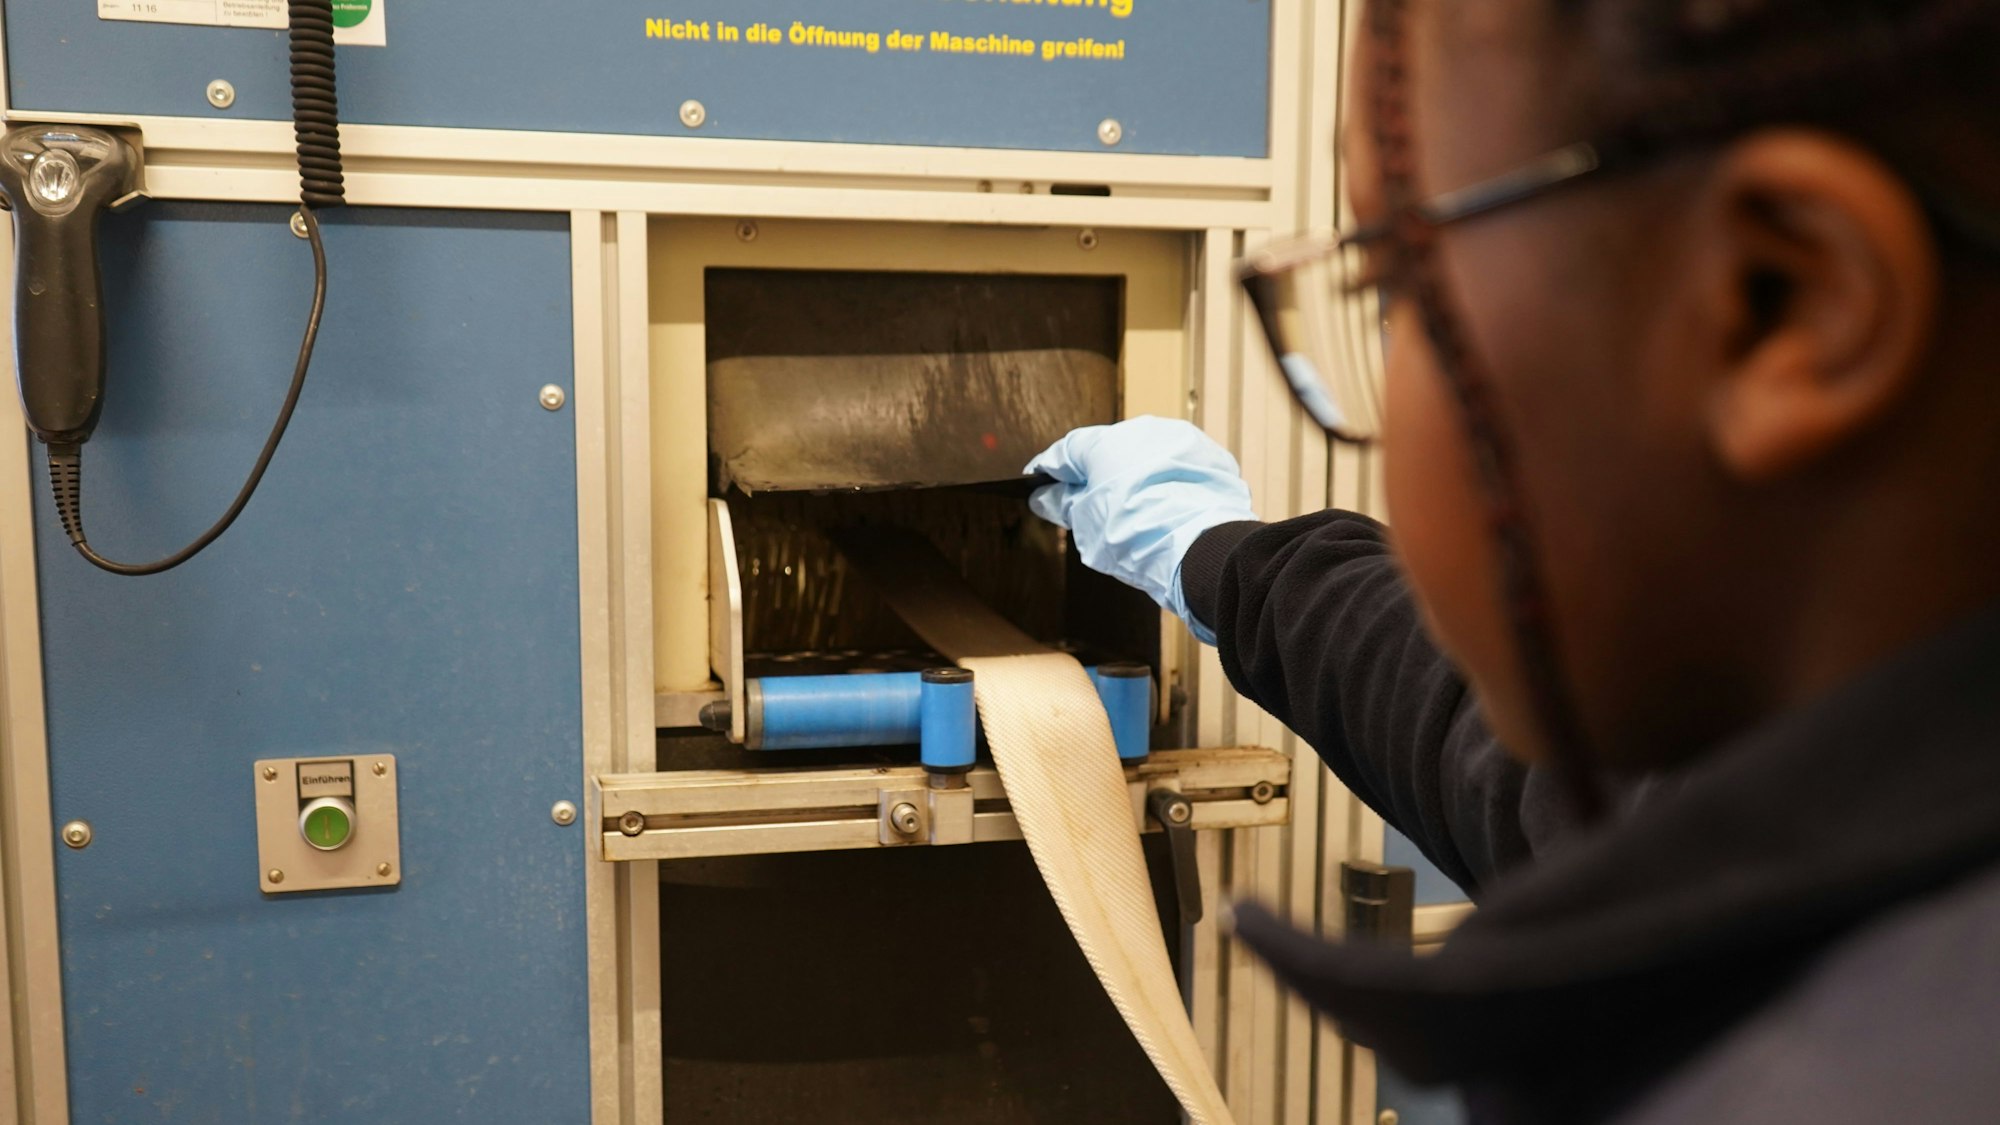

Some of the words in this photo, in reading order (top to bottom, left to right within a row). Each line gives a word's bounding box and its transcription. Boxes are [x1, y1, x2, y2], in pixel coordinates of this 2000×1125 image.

[132, 3, 142, 12] 11
[146, 4, 157, 13] 16
[645, 18, 710, 41] Nicht
[717, 21, 739, 41] in
[745, 23, 782, 44] die
[788, 22, 880, 53] Öffnung
[886, 30, 924, 50] der
[930, 31, 1035, 55] Maschine
[1041, 38, 1125, 60] greifen!
[302, 775, 350, 785] Einführen
